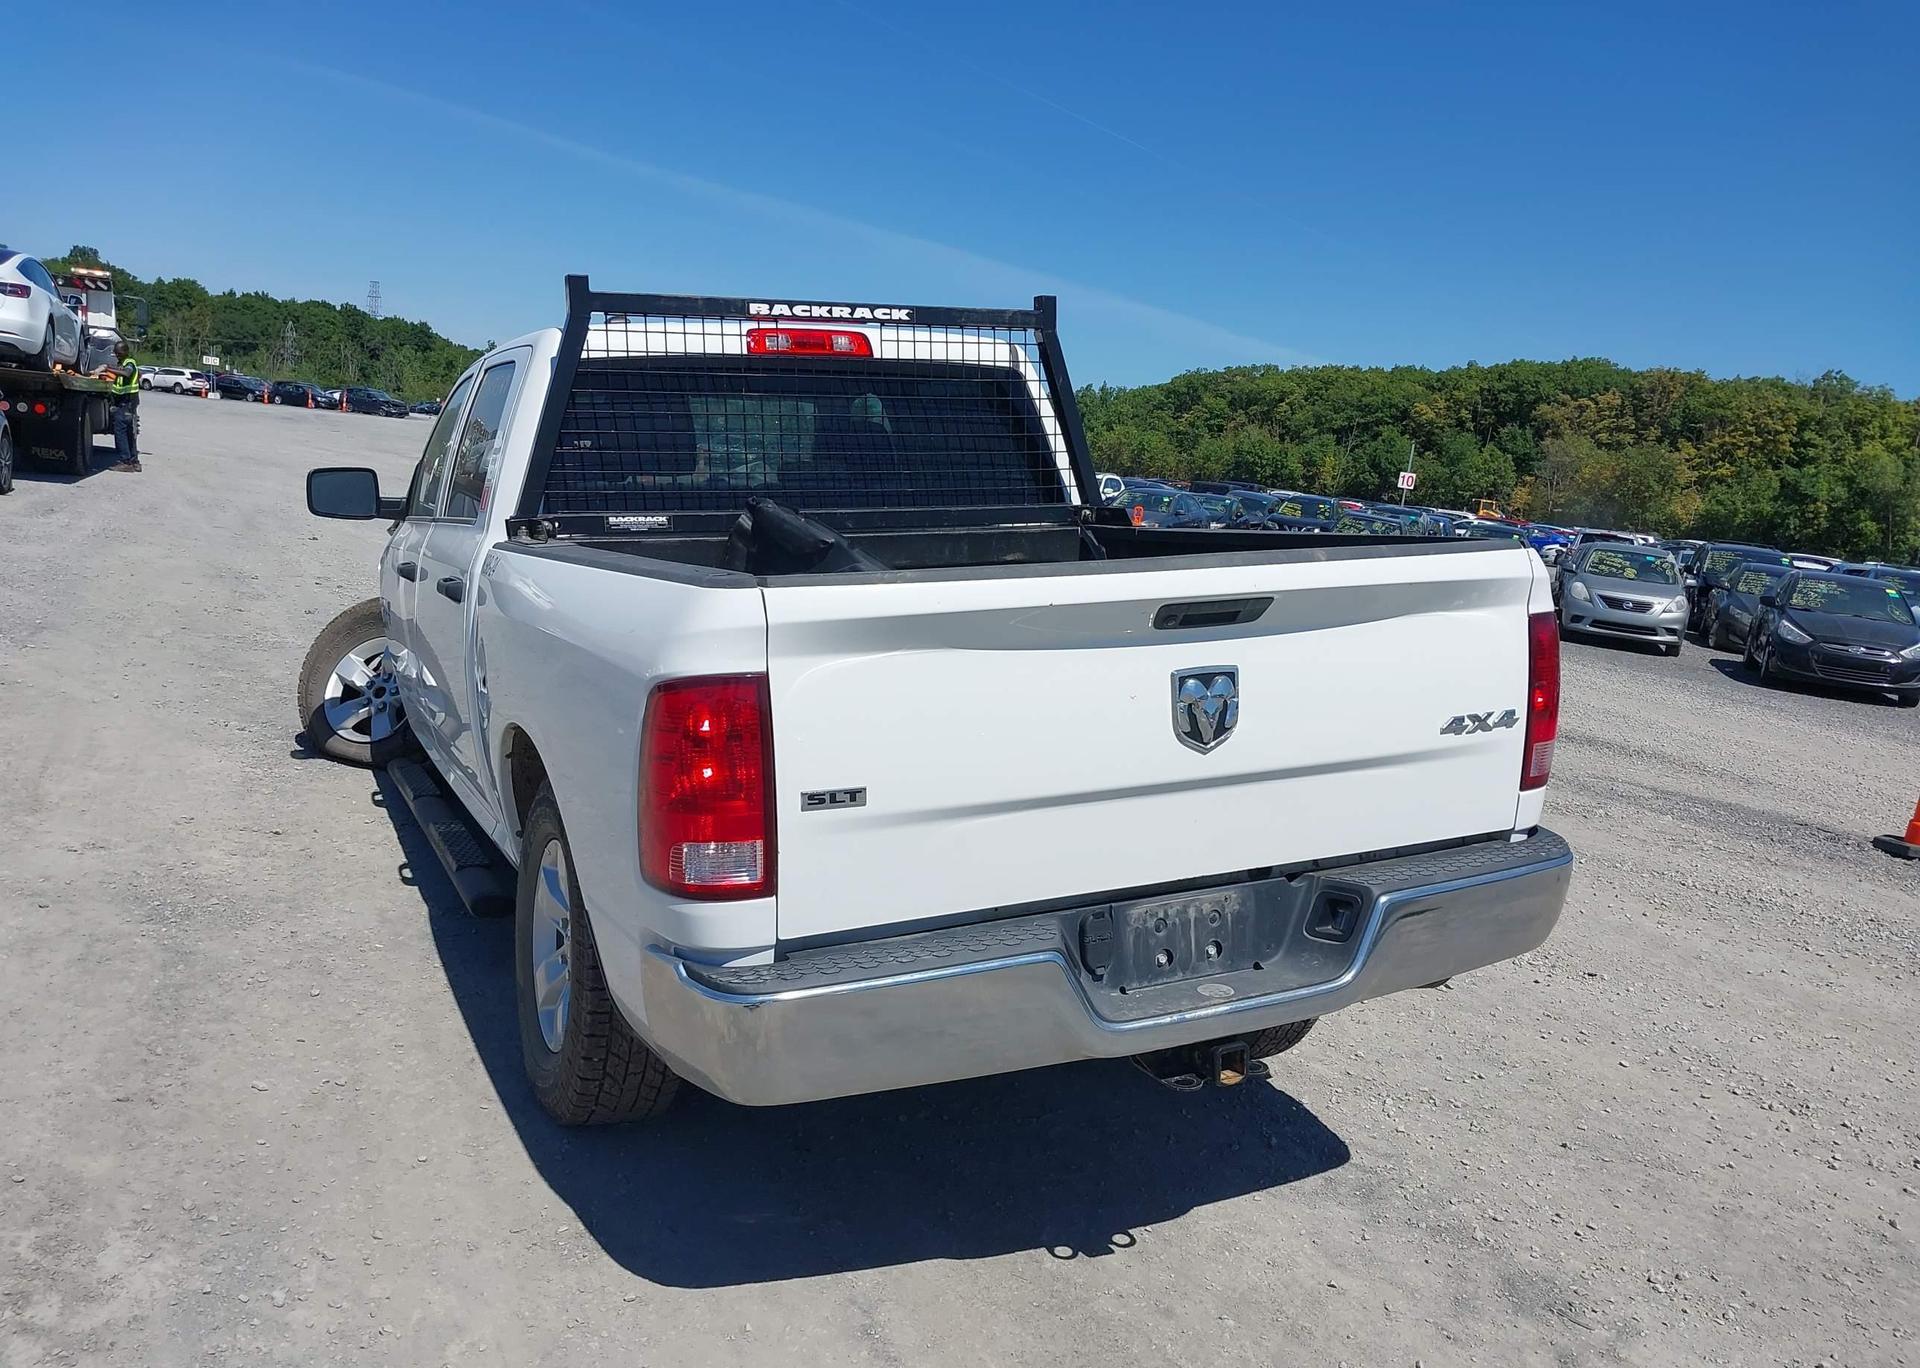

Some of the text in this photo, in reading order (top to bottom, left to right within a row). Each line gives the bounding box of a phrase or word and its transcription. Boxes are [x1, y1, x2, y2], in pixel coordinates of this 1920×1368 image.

[748, 302, 912, 321] BACKRACK
[1401, 474, 1414, 487] 10
[807, 790, 863, 806] SLT
